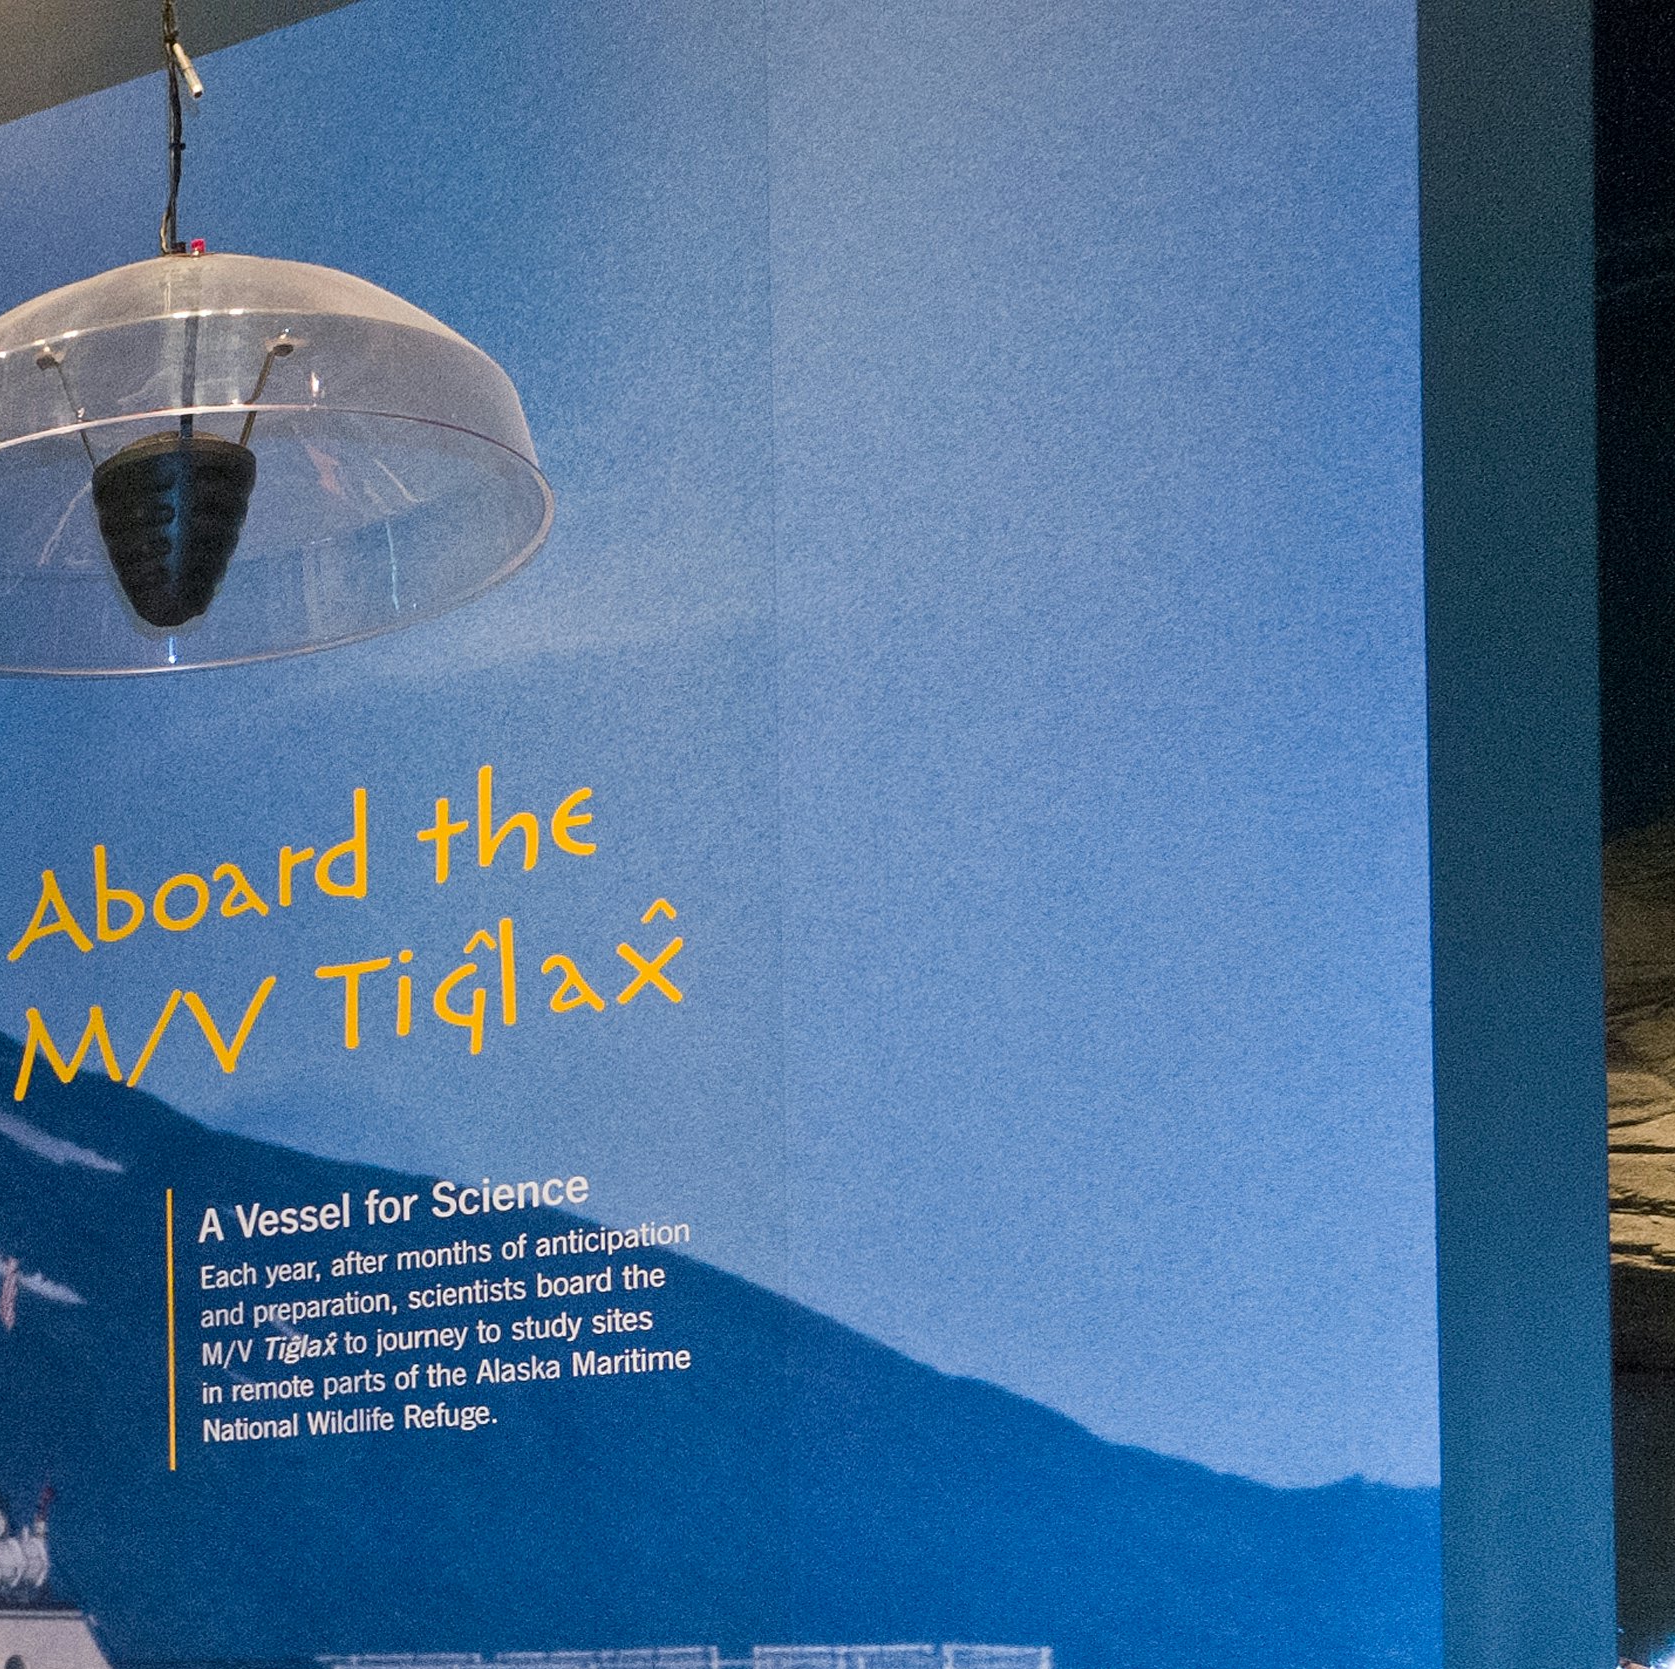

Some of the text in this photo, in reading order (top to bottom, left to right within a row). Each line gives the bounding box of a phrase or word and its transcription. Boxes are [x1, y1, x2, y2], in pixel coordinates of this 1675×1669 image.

[7, 765, 597, 961] Aboard the
[14, 975, 277, 1102] M/V
[198, 1174, 589, 1243] A Vessel for Science
[201, 1219, 691, 1290] Each year, after months of anticipation
[201, 1262, 666, 1328] and preparation, scientists board the
[202, 1338, 252, 1369] M/V
[344, 1331, 367, 1355] to
[375, 1323, 468, 1357] journey
[476, 1317, 502, 1343] to
[511, 1311, 582, 1342] study
[591, 1305, 653, 1335] sites
[202, 1346, 692, 1405] in remote parts of the Alaska Maritime
[203, 1401, 498, 1443] National Wildlife Refuge.
